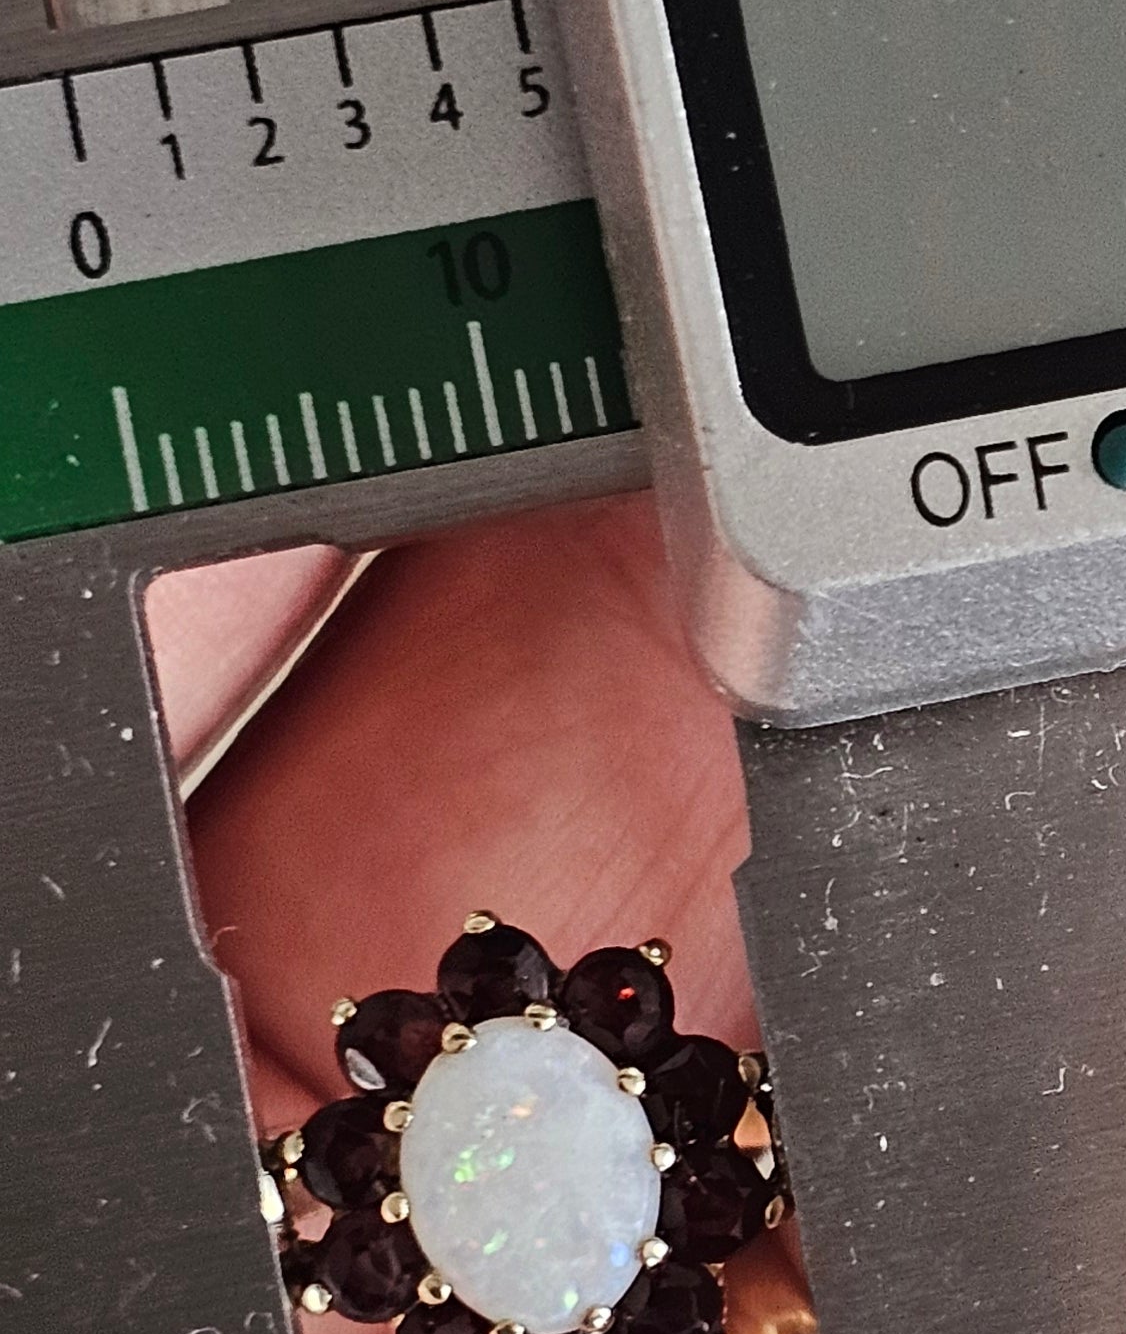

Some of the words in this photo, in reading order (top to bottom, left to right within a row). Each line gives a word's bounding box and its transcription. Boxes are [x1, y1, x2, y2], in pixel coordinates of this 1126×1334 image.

[161, 133, 186, 180] 1
[247, 117, 285, 167] 2
[336, 99, 372, 150] 3
[429, 82, 464, 130] 4
[519, 66, 551, 118] 5
[69, 211, 112, 279] 0
[426, 230, 513, 307] 10
[910, 430, 1070, 528] OFF
